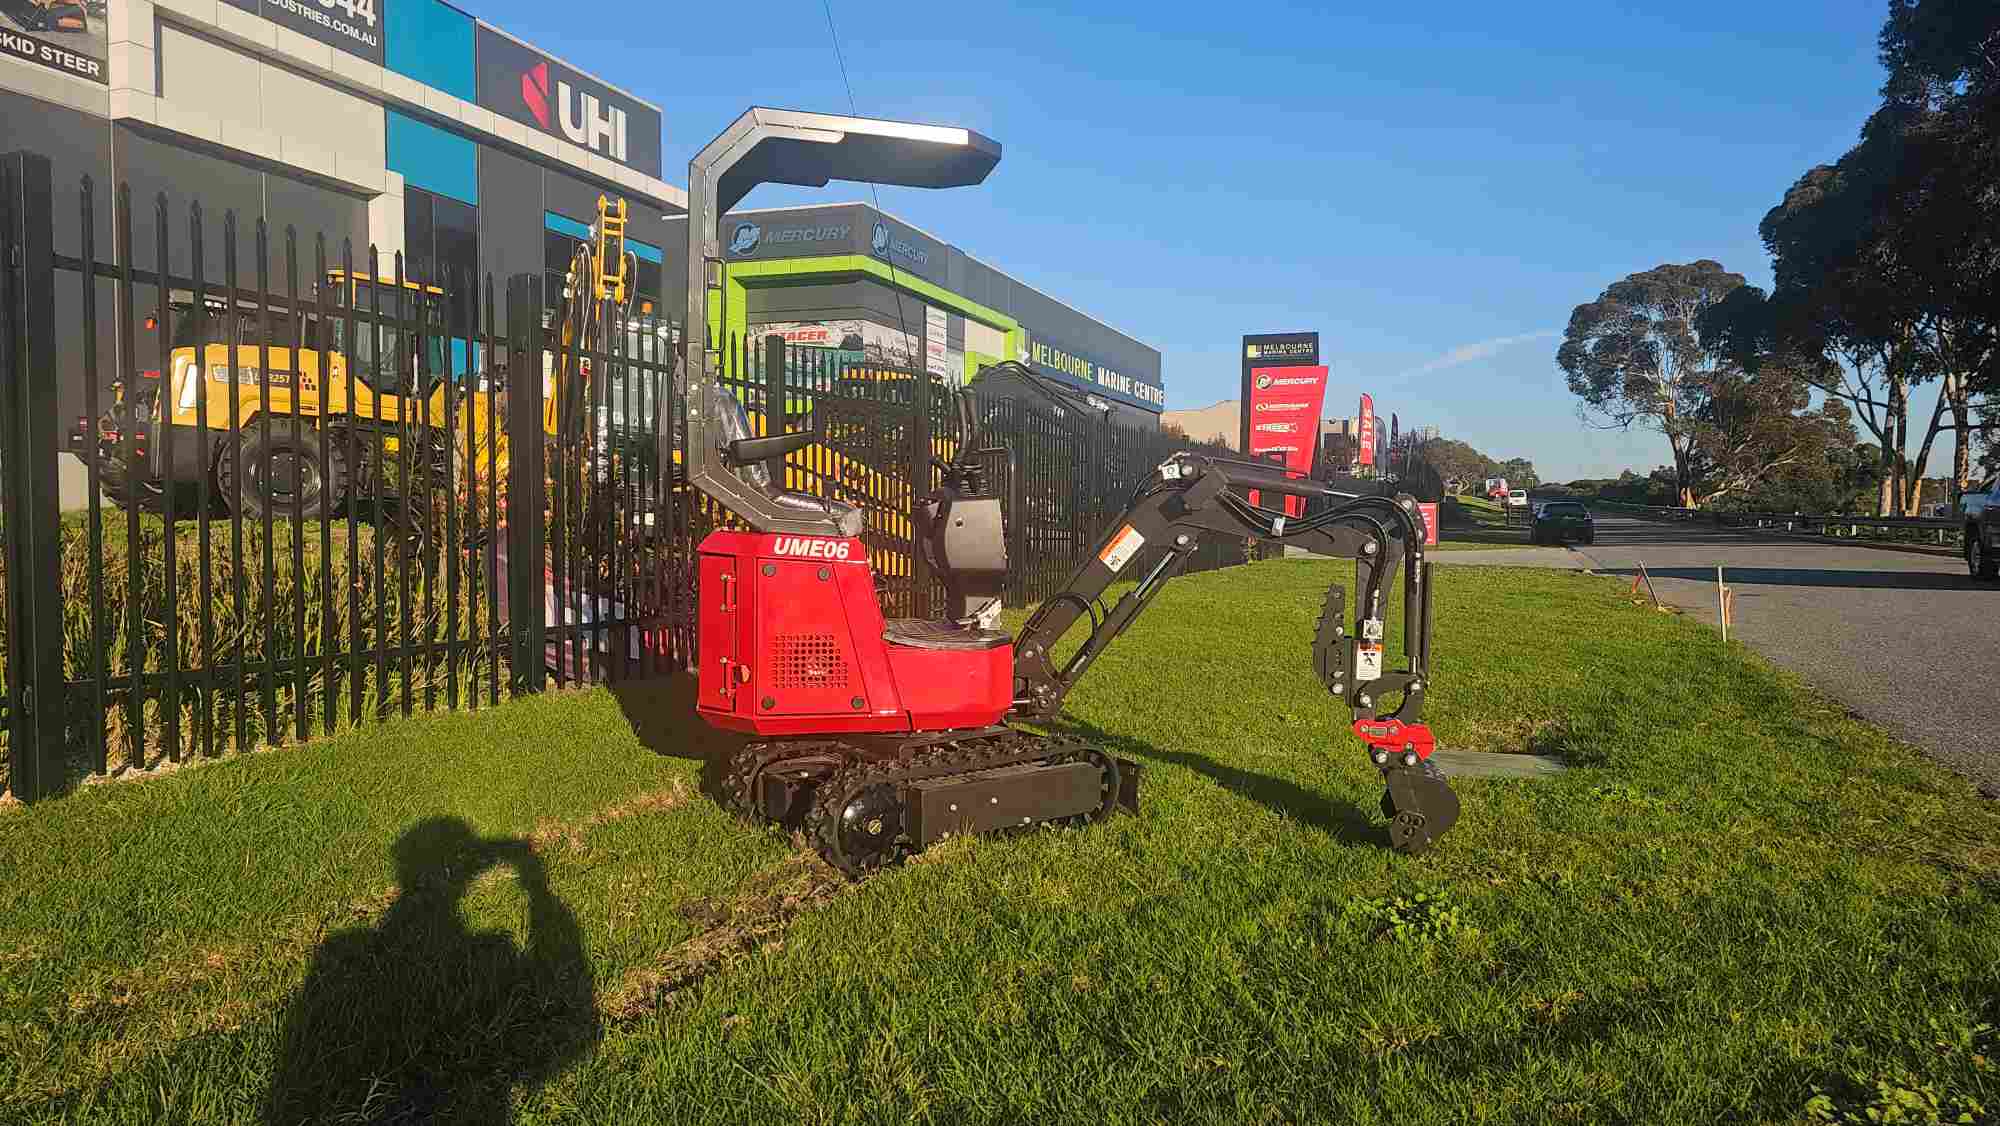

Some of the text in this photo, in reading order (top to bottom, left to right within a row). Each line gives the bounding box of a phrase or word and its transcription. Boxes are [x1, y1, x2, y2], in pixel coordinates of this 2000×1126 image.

[0, 32, 100, 77] KID STEER
[558, 80, 626, 162] UHI
[766, 224, 851, 243] MERCURY
[888, 239, 929, 265] MERCURY
[1032, 341, 1165, 406] MELBOURNE MARINE CENTRE
[1272, 377, 1319, 385] MERCURY
[774, 537, 849, 559] UME06
